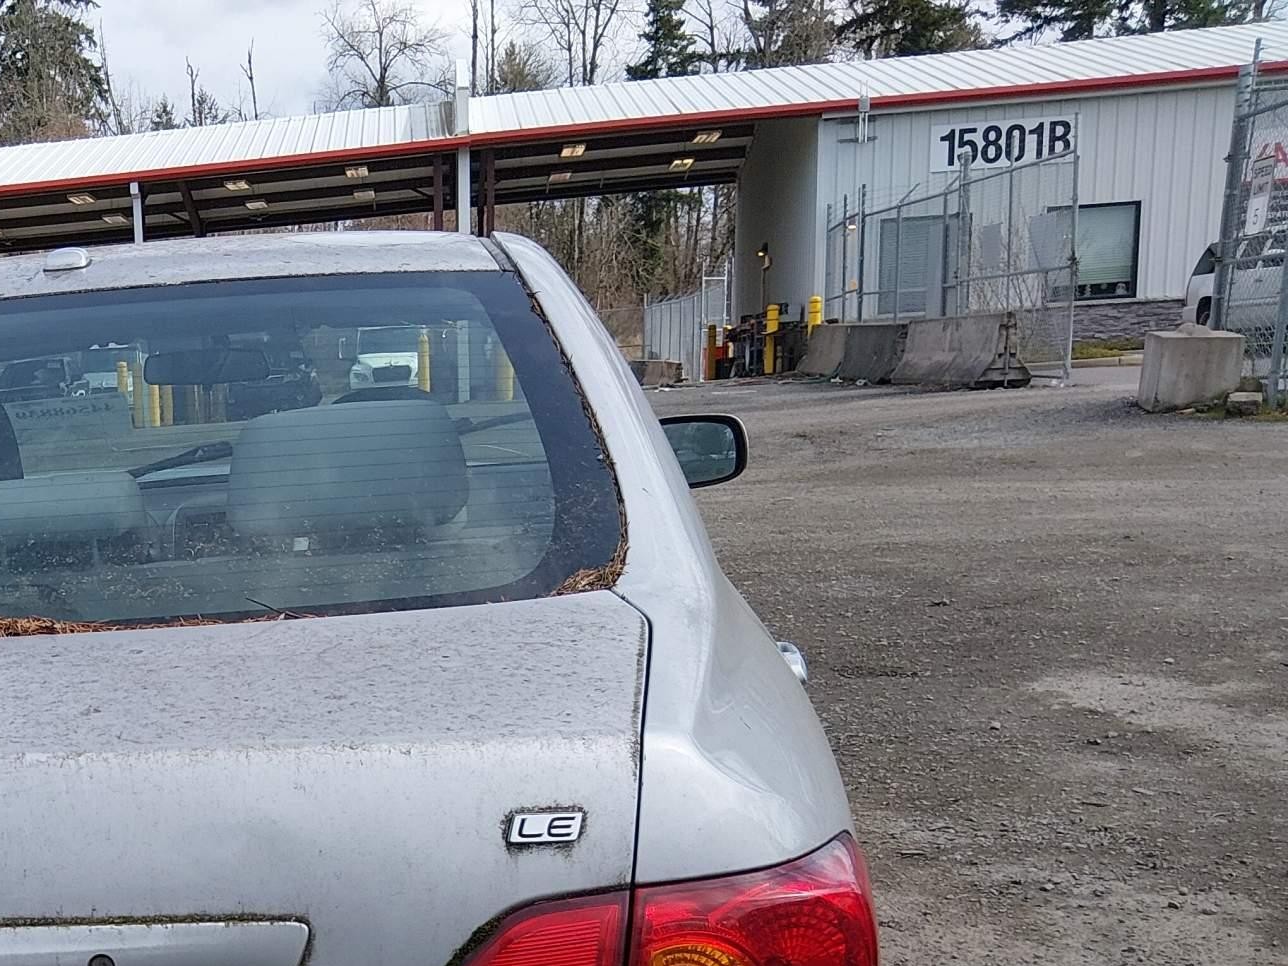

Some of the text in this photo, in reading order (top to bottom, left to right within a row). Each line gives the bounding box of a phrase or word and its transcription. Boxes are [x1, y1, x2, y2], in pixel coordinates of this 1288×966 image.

[940, 120, 1072, 167] 15801B
[1252, 207, 1260, 225] 5
[518, 816, 577, 838] LE
